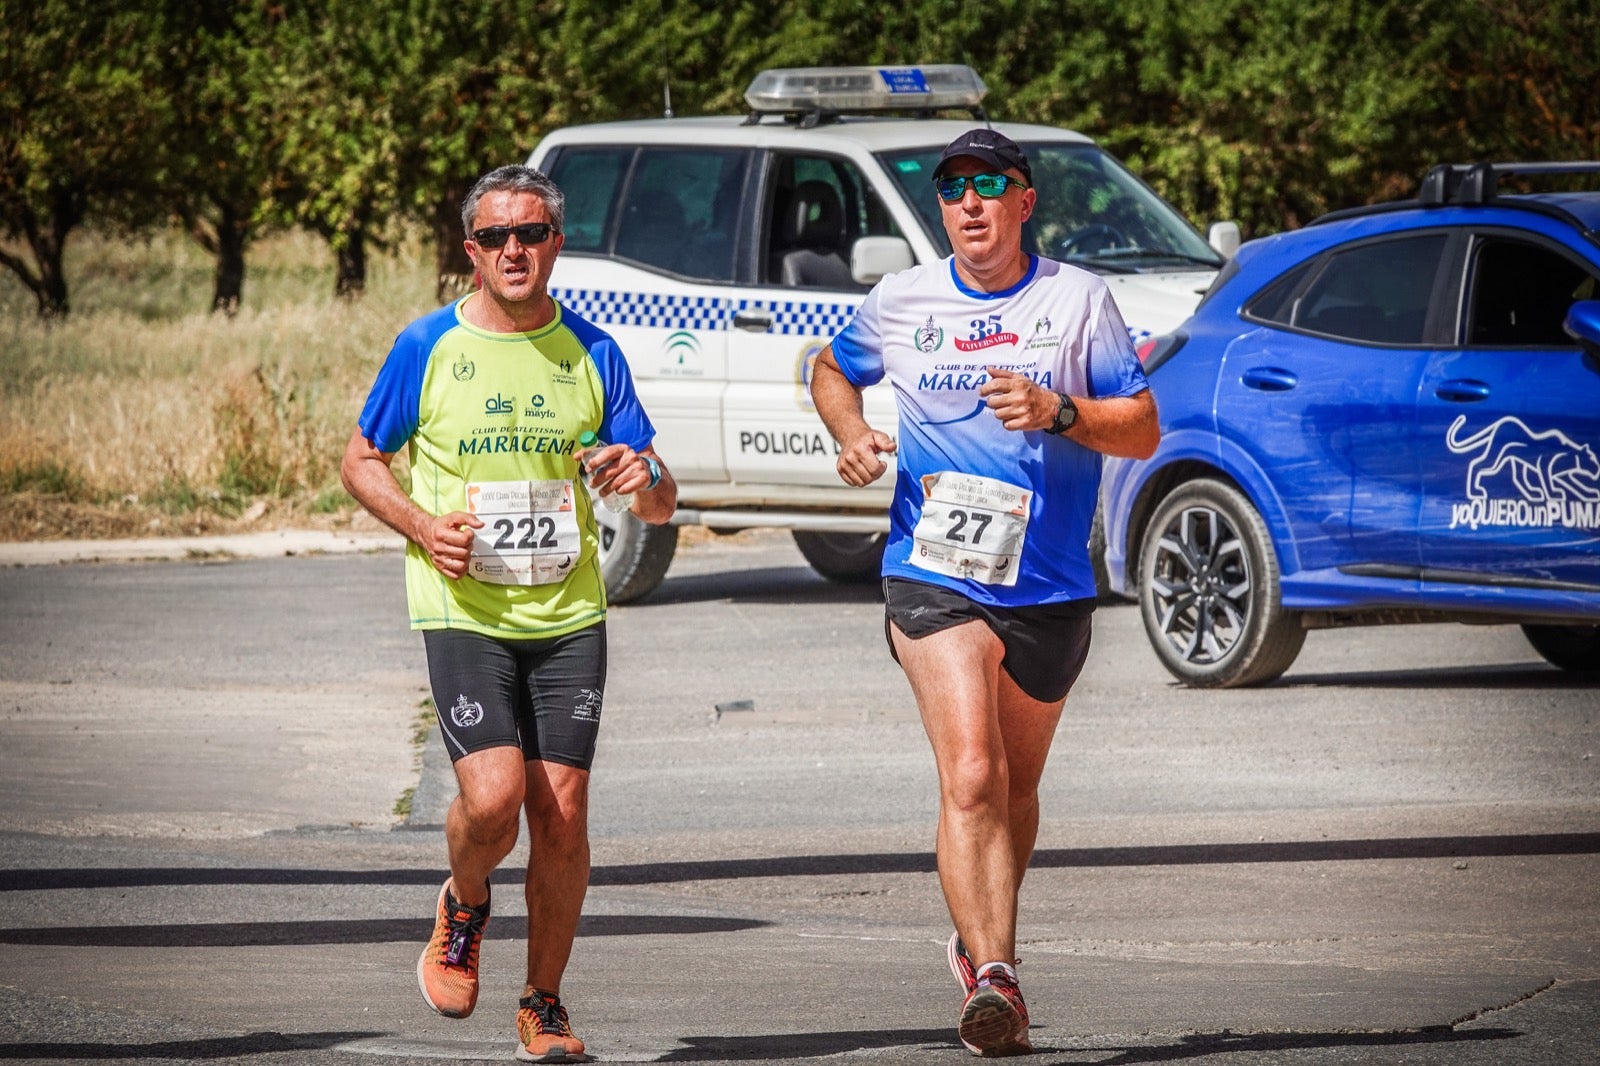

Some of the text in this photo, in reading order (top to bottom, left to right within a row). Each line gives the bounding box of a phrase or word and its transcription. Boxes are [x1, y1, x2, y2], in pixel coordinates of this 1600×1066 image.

[969, 314, 1003, 342] 35
[934, 363, 961, 371] CLUB
[472, 427, 497, 435] CLUB
[512, 427, 564, 435] ATLETISMO
[740, 431, 827, 455] POLICIA
[458, 435, 575, 456] MARACENA
[493, 517, 558, 550] 222
[945, 510, 993, 545] 27
